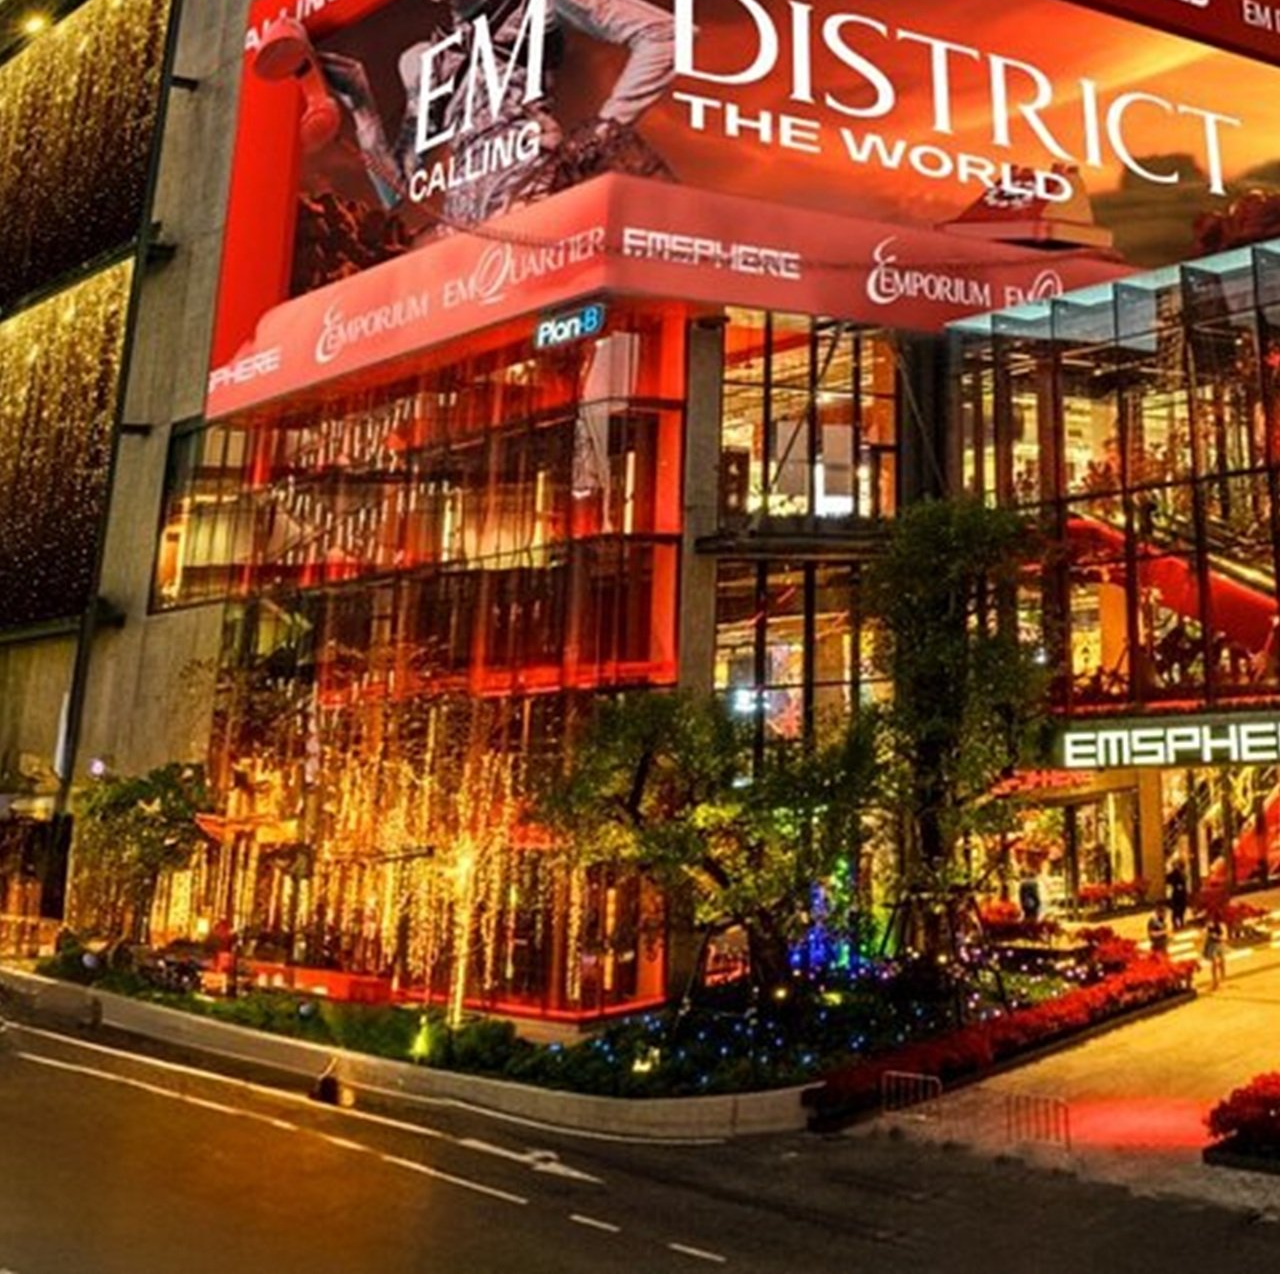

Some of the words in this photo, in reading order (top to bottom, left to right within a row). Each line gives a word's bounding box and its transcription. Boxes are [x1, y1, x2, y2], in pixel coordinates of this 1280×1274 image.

[408, 121, 543, 204] CALLING
[673, 91, 821, 154] THE
[840, 127, 1074, 203] WORLD
[623, 226, 801, 280] EMSPHERE
[866, 236, 991, 308] EMPORIUM
